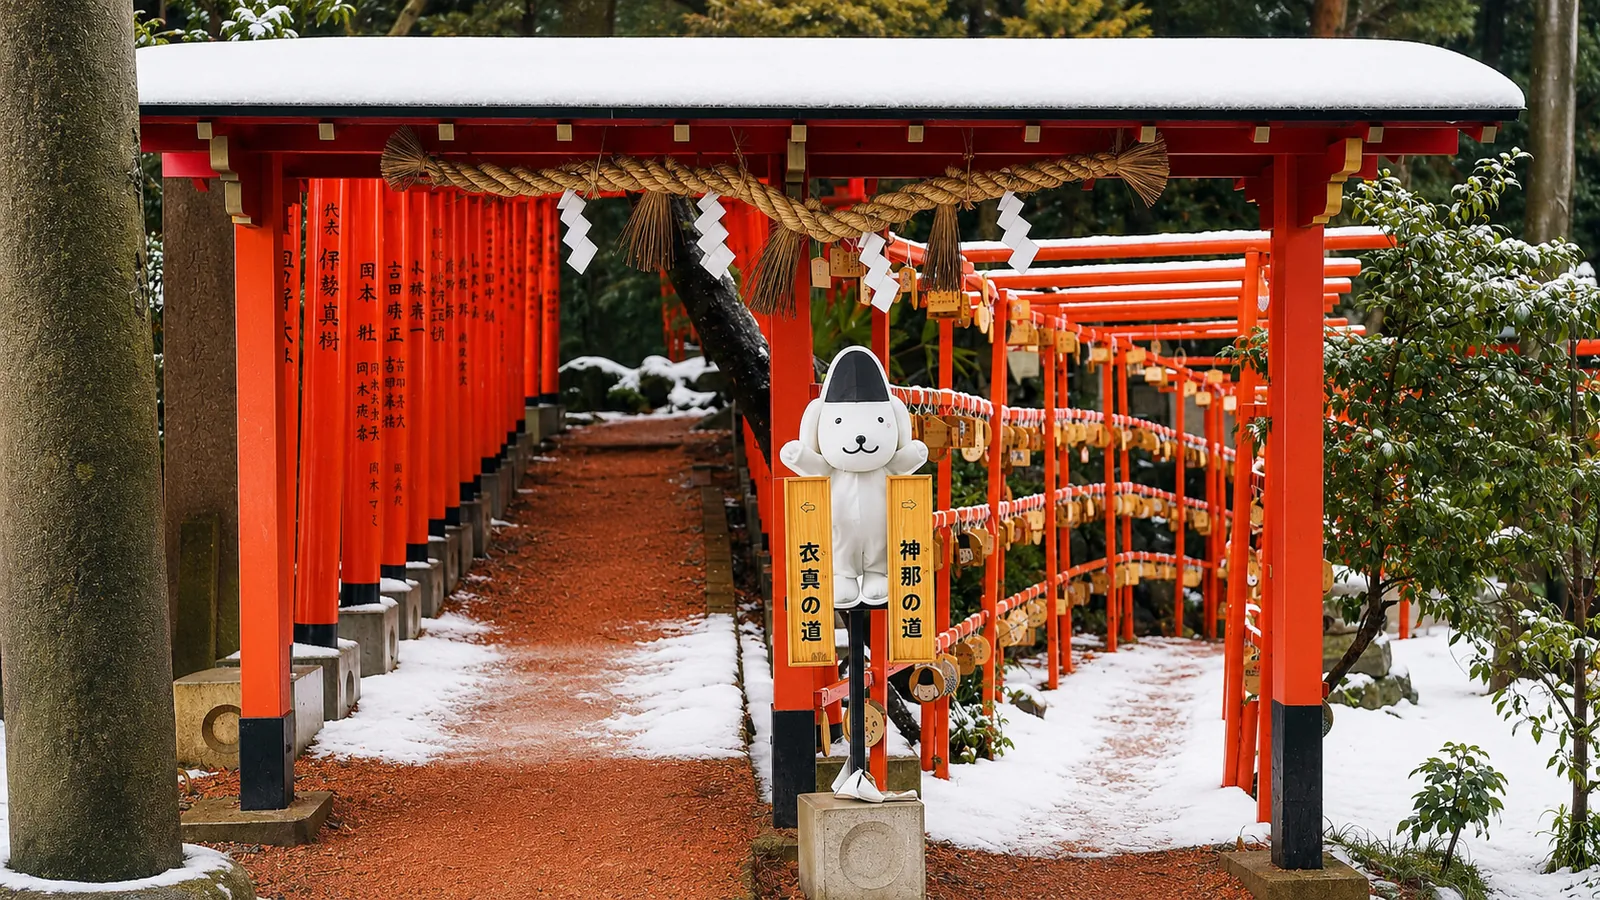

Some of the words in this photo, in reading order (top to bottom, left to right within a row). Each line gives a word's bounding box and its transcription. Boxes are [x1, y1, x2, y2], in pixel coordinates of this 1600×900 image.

[799, 541, 823, 643] 衣真の道
[899, 539, 923, 639] 神那の道
